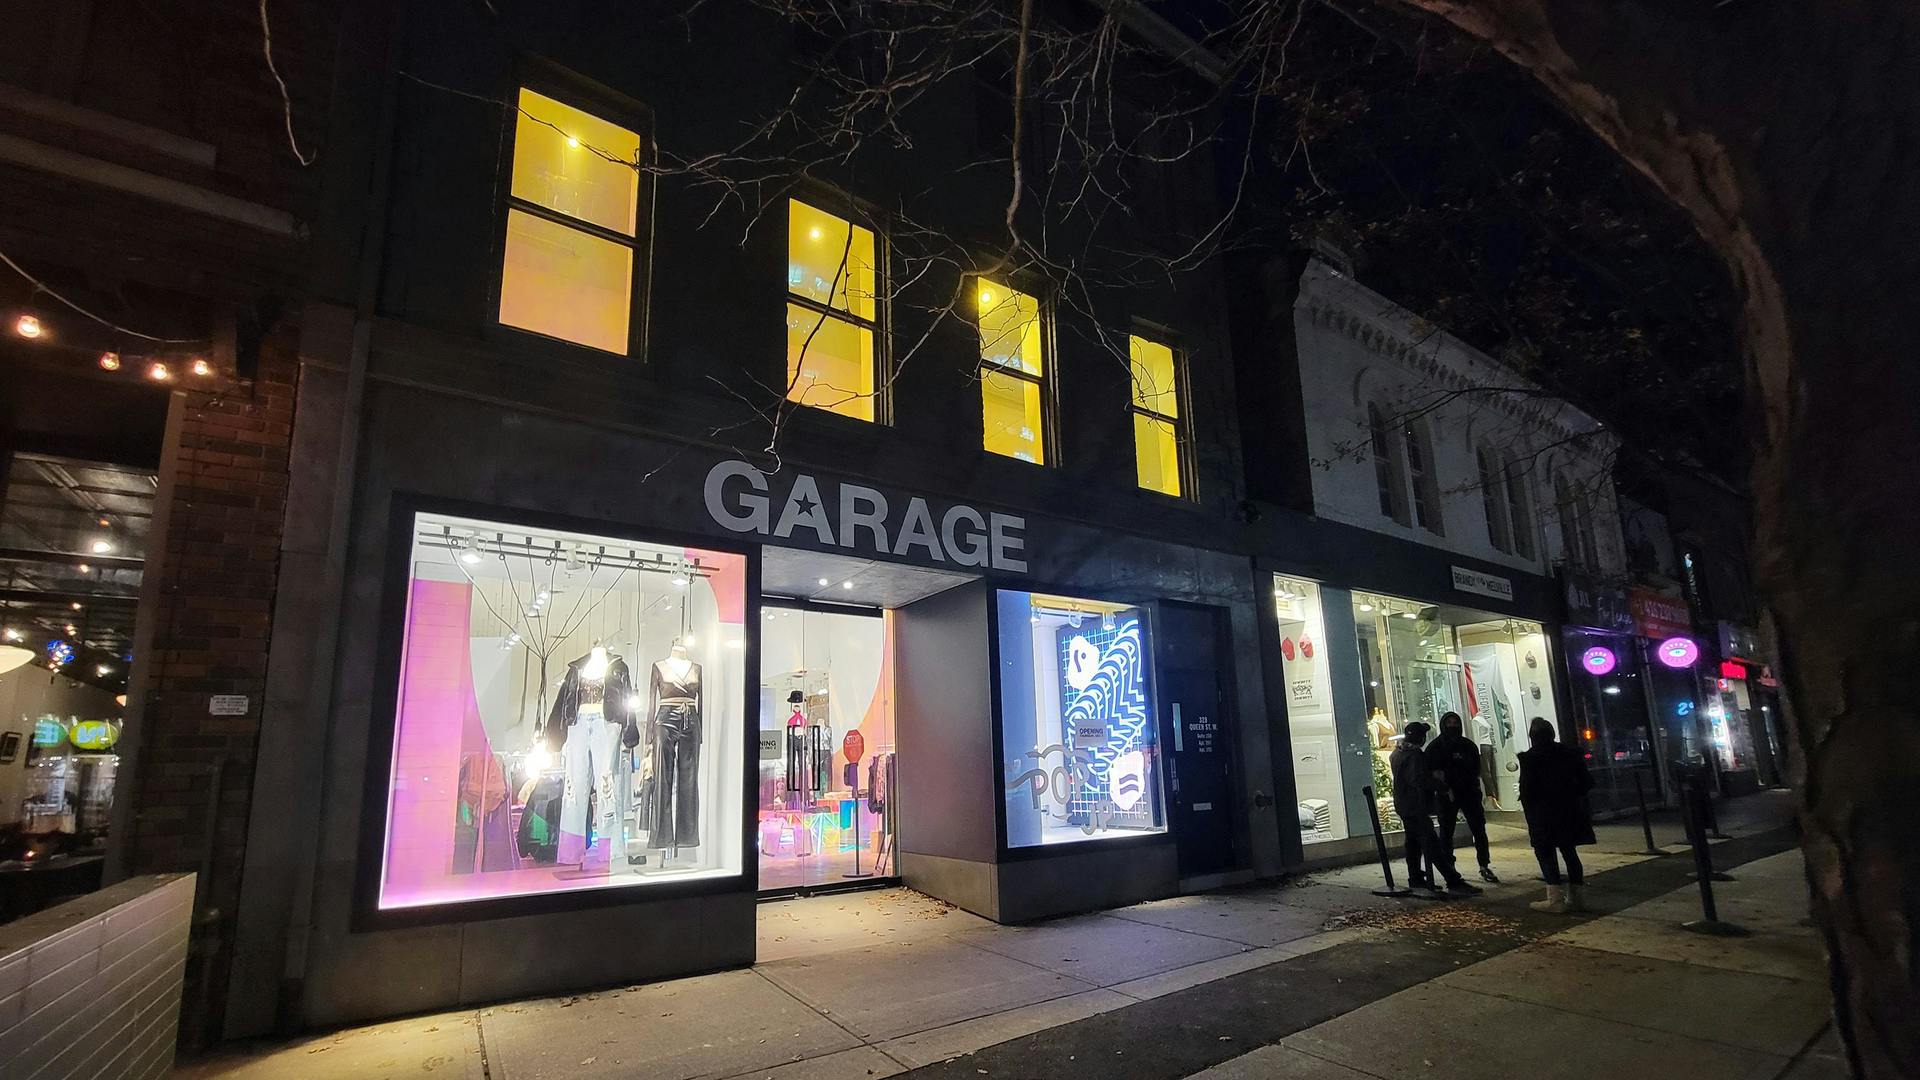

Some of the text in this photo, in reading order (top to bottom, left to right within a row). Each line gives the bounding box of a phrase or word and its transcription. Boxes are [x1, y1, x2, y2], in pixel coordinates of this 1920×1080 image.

[703, 459, 1028, 573] GARAGE
[1477, 682, 1491, 719] CALIFORNIA
[1189, 723, 1204, 731] QUEEN
[1006, 761, 1090, 809] POP
